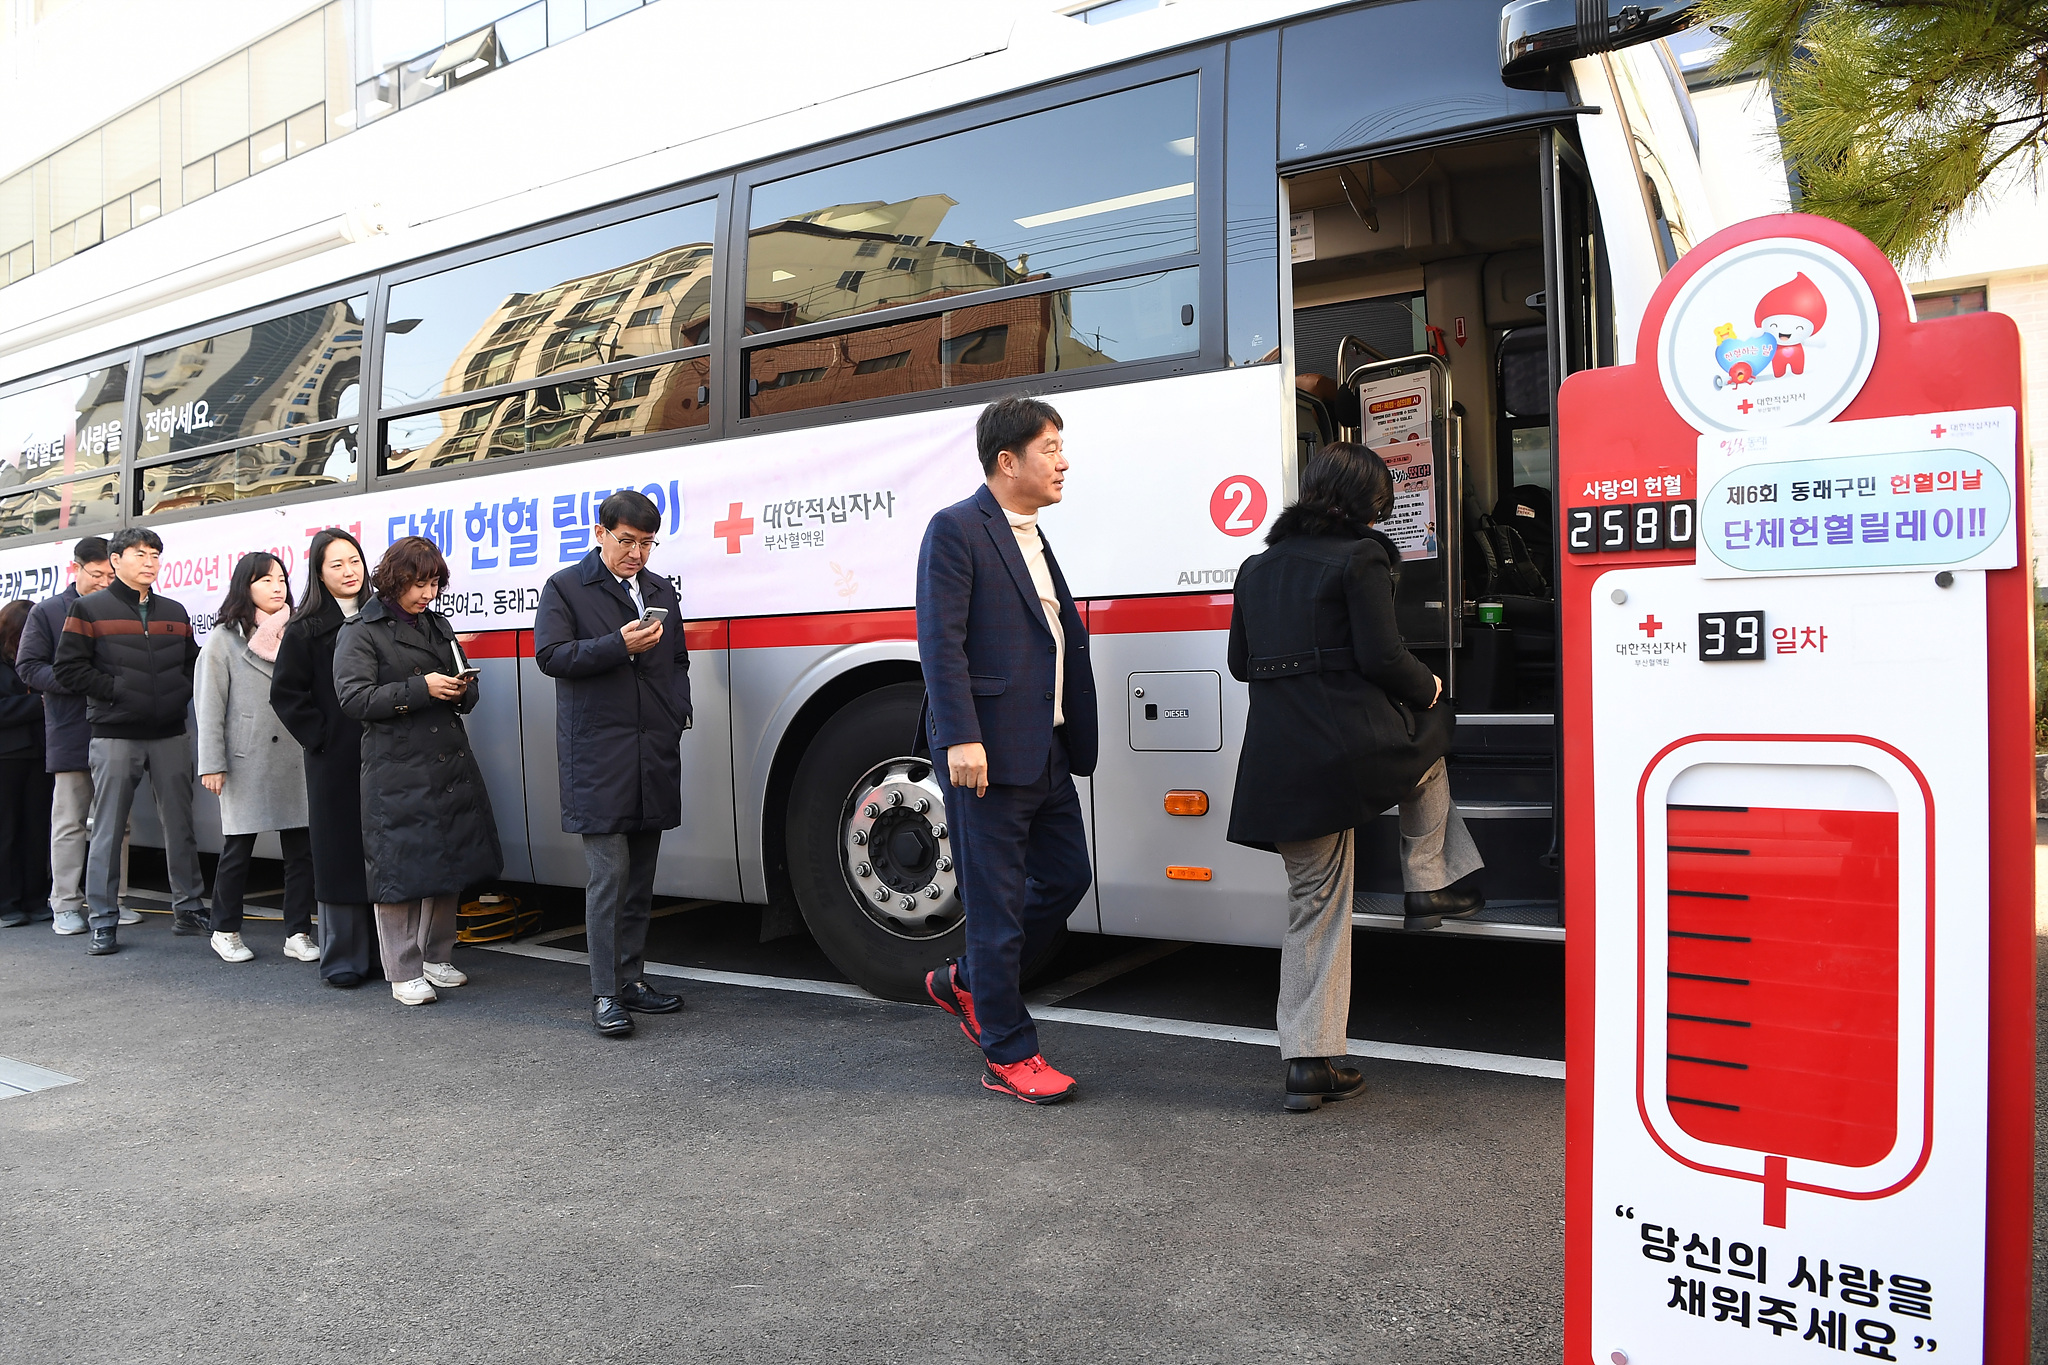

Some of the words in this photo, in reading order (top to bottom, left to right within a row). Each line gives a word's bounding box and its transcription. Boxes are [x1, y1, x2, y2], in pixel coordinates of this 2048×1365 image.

[1724, 346, 1758, 361] 헌혈하는
[1762, 344, 1773, 356] 날
[1756, 393, 1806, 406] 대한적십자사
[78, 420, 122, 456] 사랑을
[145, 401, 214, 442] 전하세요.
[1223, 482, 1253, 529] 2
[1583, 478, 1638, 500] 사랑의
[1643, 474, 1681, 497] 헌혈
[1726, 484, 1778, 505] 제6회
[1791, 476, 1876, 502] 동래구민
[1890, 469, 1983, 494] 헌혈의날
[464, 497, 539, 570] 헌혈
[552, 480, 680, 563] 릴이
[763, 491, 895, 529] 대한적십자사
[1571, 504, 1692, 547] 2580
[1724, 507, 1986, 550] 단체헌혈릴레이!!
[764, 530, 825, 550] 부산혈액원
[0, 565, 58, 601] 래구민
[1616, 641, 1687, 656] 대한적십자사
[1704, 616, 1759, 655] 39
[1771, 626, 1828, 654] 일차
[1164, 710, 1188, 718] DIESEL
[1787, 1255, 1933, 1320] 사랑을
